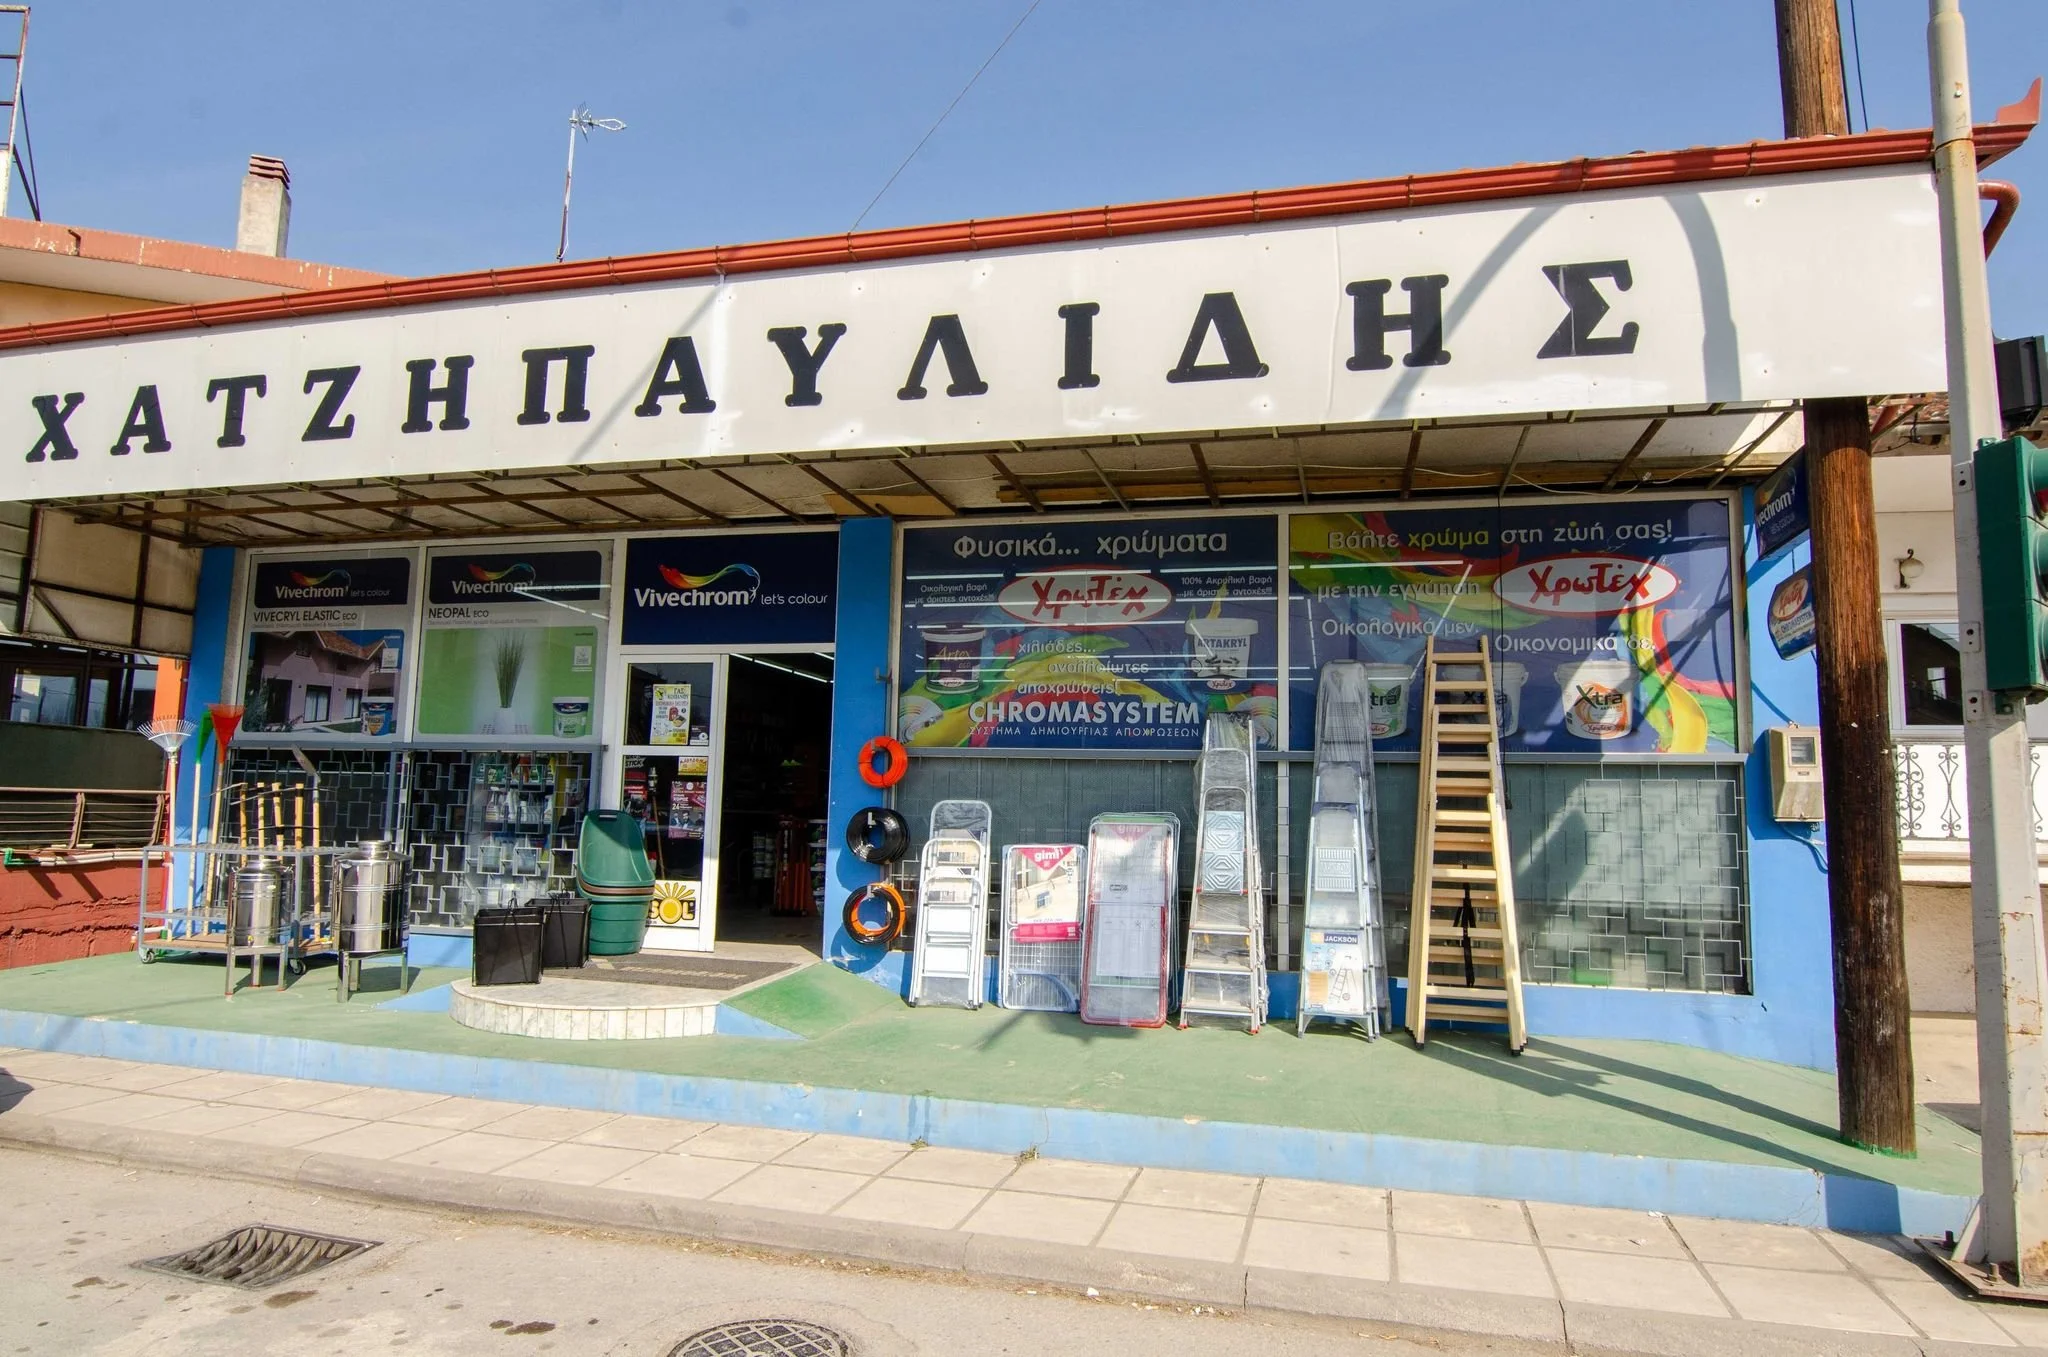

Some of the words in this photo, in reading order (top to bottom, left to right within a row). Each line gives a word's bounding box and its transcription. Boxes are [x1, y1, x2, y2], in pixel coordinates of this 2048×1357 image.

[26, 260, 1640, 464] ΧΑΤΖΗΠΑΥΛΙΔΗΣ
[1328, 527, 1399, 550] Βάλτε
[1408, 522, 1490, 551] χρώμα
[1501, 527, 1543, 545] στη
[1615, 518, 1673, 540] σας!
[953, 533, 1080, 559] Φυσικά...
[1097, 530, 1228, 560] χρώματα
[452, 581, 529, 595] Vivechrom
[1181, 576, 1203, 585] 100%
[275, 585, 345, 600] Vivechrom
[634, 588, 749, 607] Vivechrom
[761, 594, 785, 606] let's
[787, 592, 829, 605] colour
[1317, 585, 1341, 603] με
[1347, 584, 1382, 598] την
[1388, 579, 1481, 601] εγγύηση
[253, 611, 301, 622] VIVECRYL
[302, 610, 341, 621] ELASTIC
[342, 612, 358, 620] ECO
[428, 607, 471, 619] NEOPAL
[473, 610, 489, 618] ECO
[1018, 637, 1097, 654] χιλιάδες...
[1197, 637, 1248, 649] ARTAKRYL
[1495, 633, 1617, 655] Οικονομικά
[1573, 685, 1624, 709] Xtra
[968, 701, 1200, 725] CHROMASYSTEM
[968, 726, 1022, 736] ΣΥΣΤΗΜΑ
[1030, 726, 1109, 737] ΔΗΜΙΟΥΡΓΙΑΣ
[1115, 727, 1200, 738] ΑΠΟΧΡΩΣΕΩΝ
[1324, 935, 1359, 944] JACKSON
